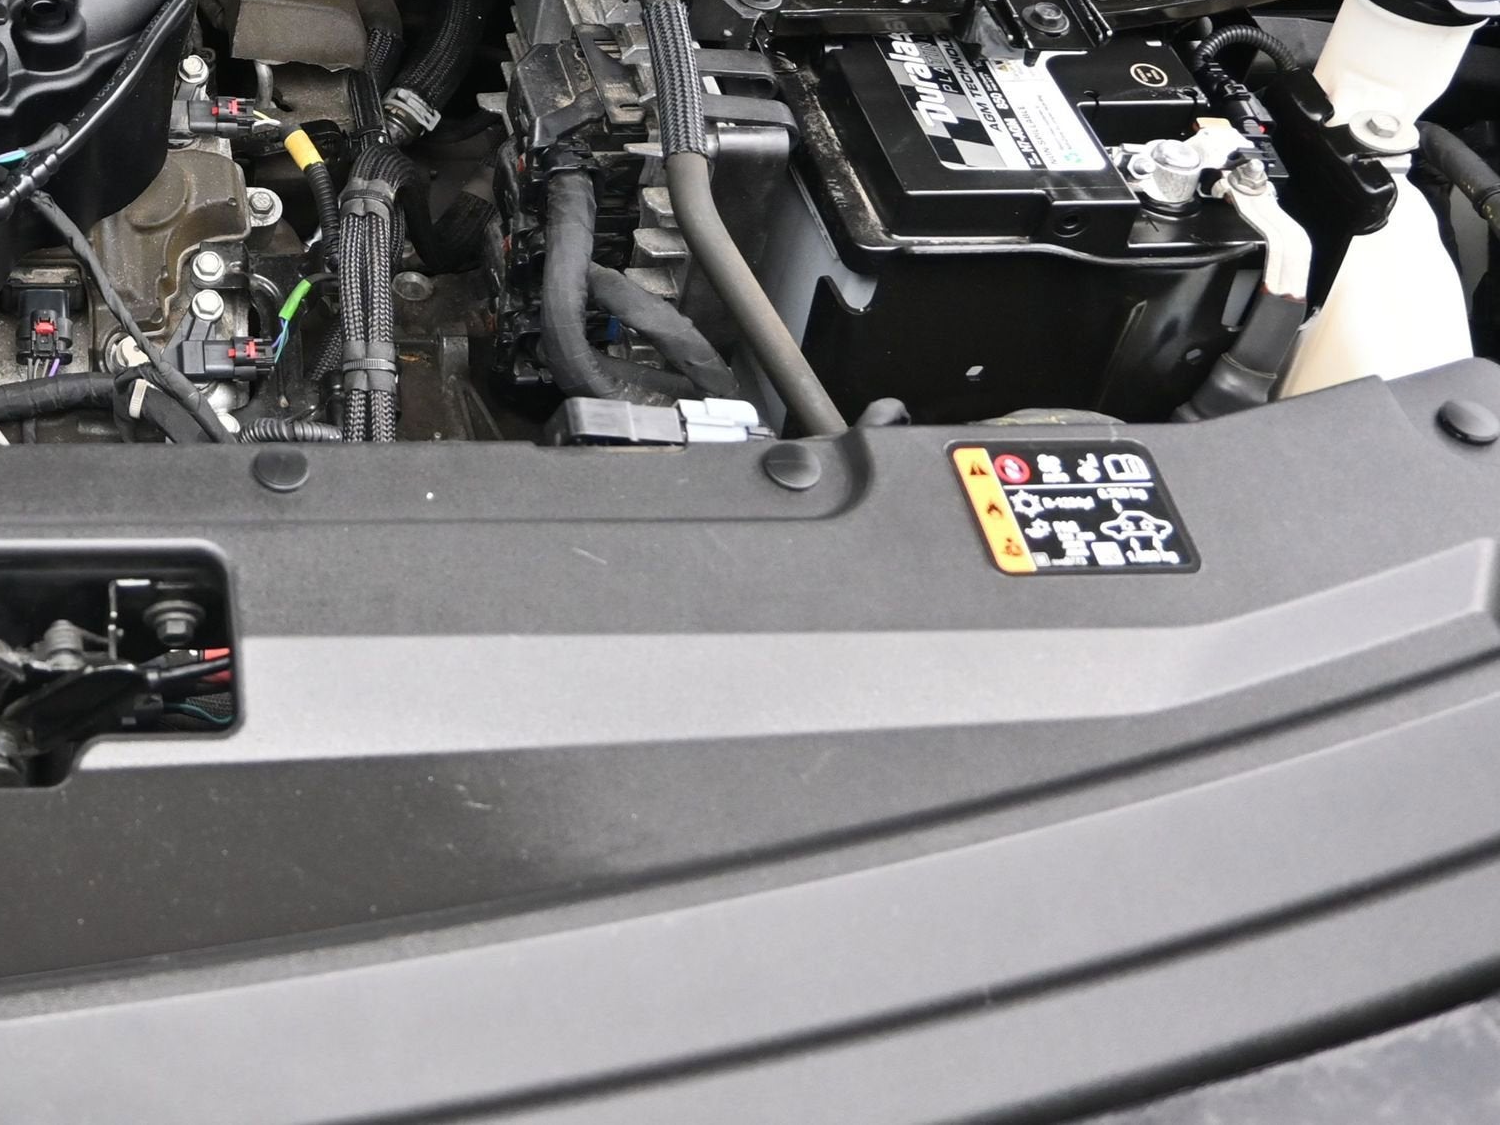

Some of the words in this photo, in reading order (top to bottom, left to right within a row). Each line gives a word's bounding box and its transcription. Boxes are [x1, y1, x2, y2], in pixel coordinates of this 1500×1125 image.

[888, 32, 959, 126] Duralas
[917, 38, 959, 93] PLATIN
[939, 34, 983, 98] TECHNOL
[976, 101, 1003, 133] AGM
[989, 91, 1010, 110] 850
[1003, 117, 1035, 153] H7-AGM
